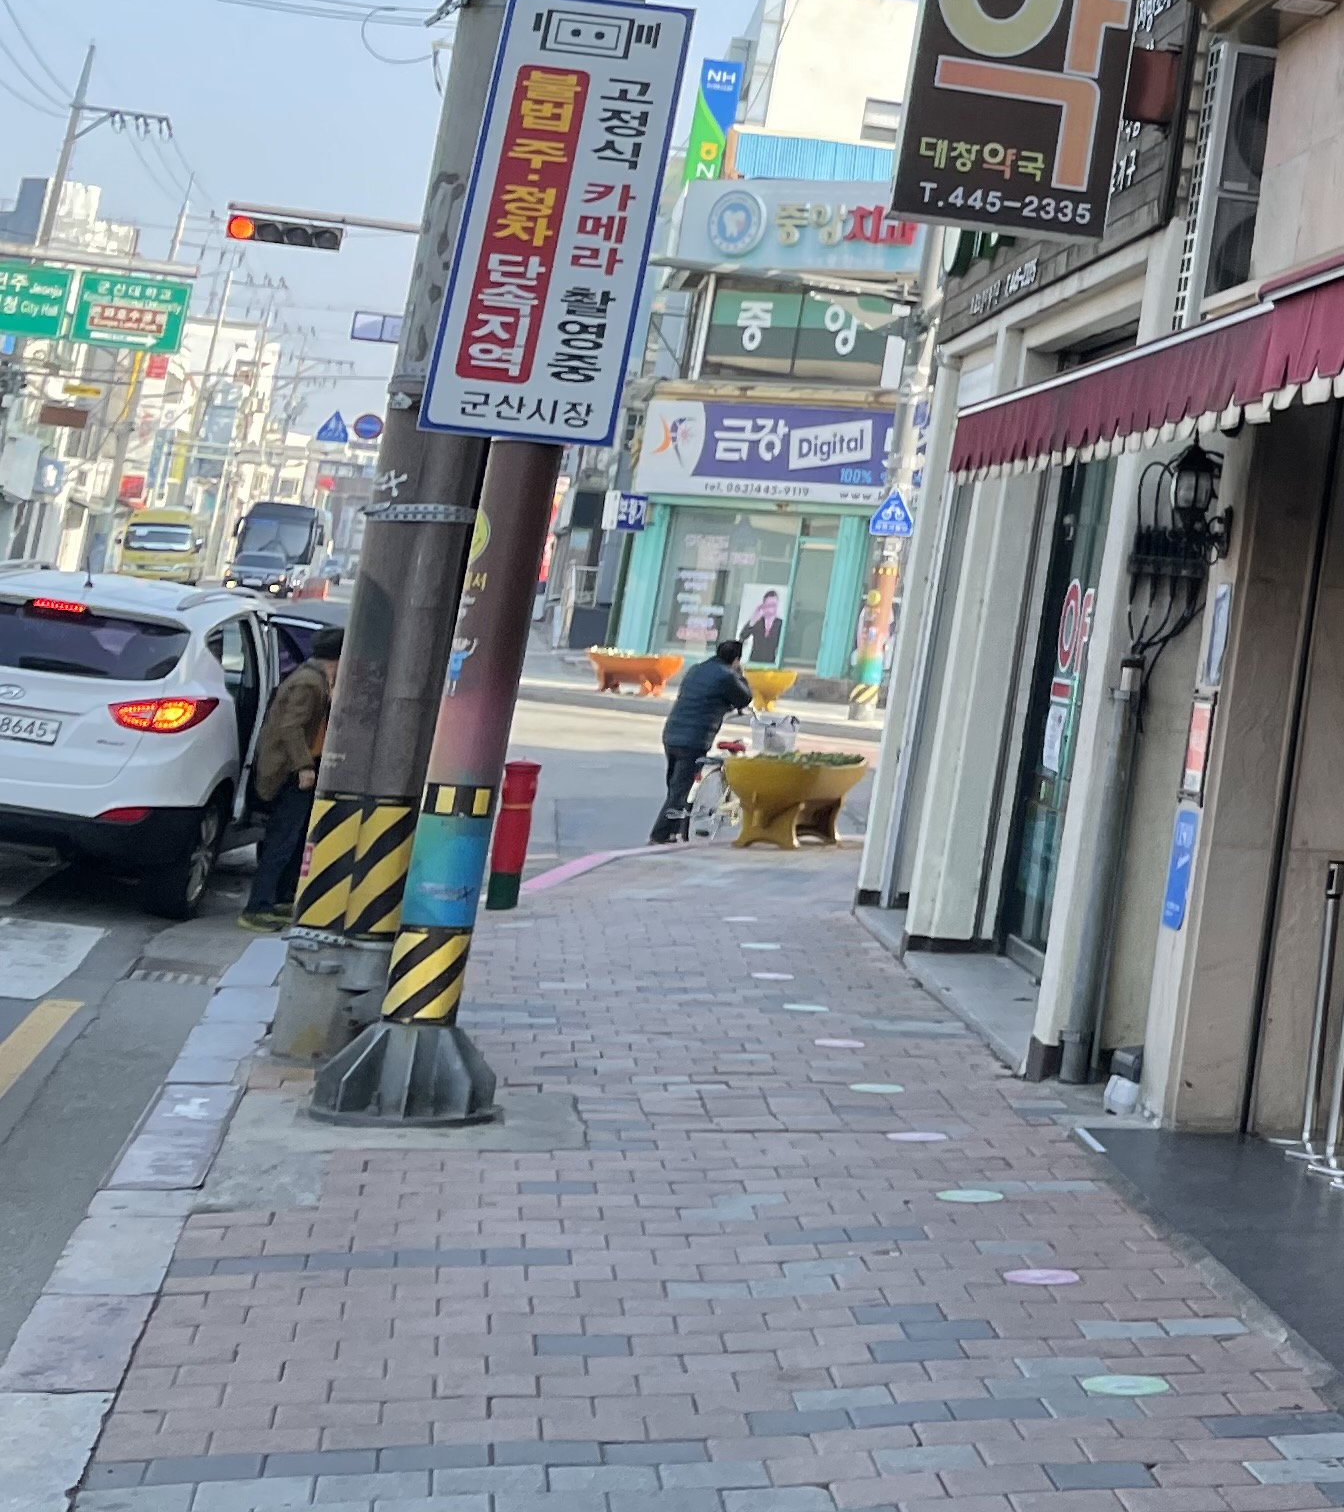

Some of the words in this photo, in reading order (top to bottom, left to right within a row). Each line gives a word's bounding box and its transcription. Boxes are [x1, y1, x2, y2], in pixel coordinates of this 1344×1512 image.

[707, 68, 737, 85] NH
[519, 69, 582, 134] 불법
[592, 77, 655, 172] 고정식
[918, 136, 1046, 182] 대창약국
[919, 180, 1092, 225] T.445-2335
[569, 181, 637, 277] 카메라
[466, 251, 547, 378] 단속지역
[459, 390, 595, 429] 군산시장
[714, 417, 790, 462] 금강
[797, 428, 864, 462] Digital
